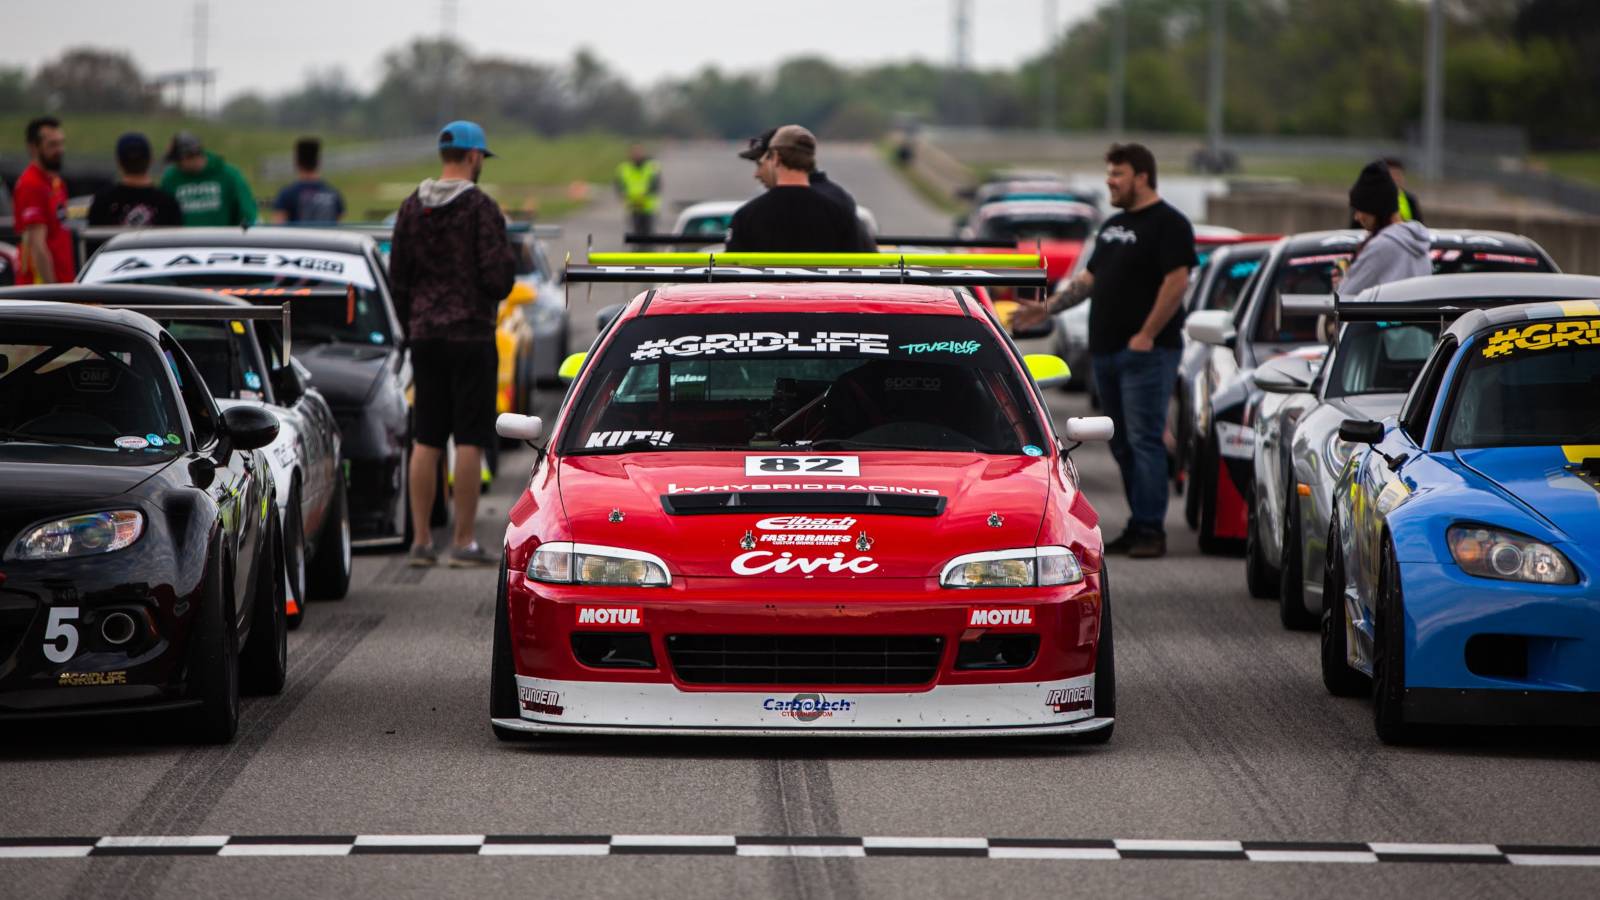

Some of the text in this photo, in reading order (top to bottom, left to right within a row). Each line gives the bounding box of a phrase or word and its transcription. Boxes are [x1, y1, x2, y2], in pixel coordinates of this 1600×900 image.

[165, 253, 301, 268] APEX
[630, 331, 890, 361] #GRIDLIFE
[898, 340, 982, 355] TOURING
[759, 457, 844, 473] 82
[755, 516, 857, 531] Eibach
[760, 534, 852, 543] FASTBRAKES
[730, 550, 879, 576] Civic
[578, 608, 640, 624] MOTUL
[970, 609, 1033, 625] MOTUL
[43, 606, 80, 663] 5
[763, 698, 850, 711] Carbotech
